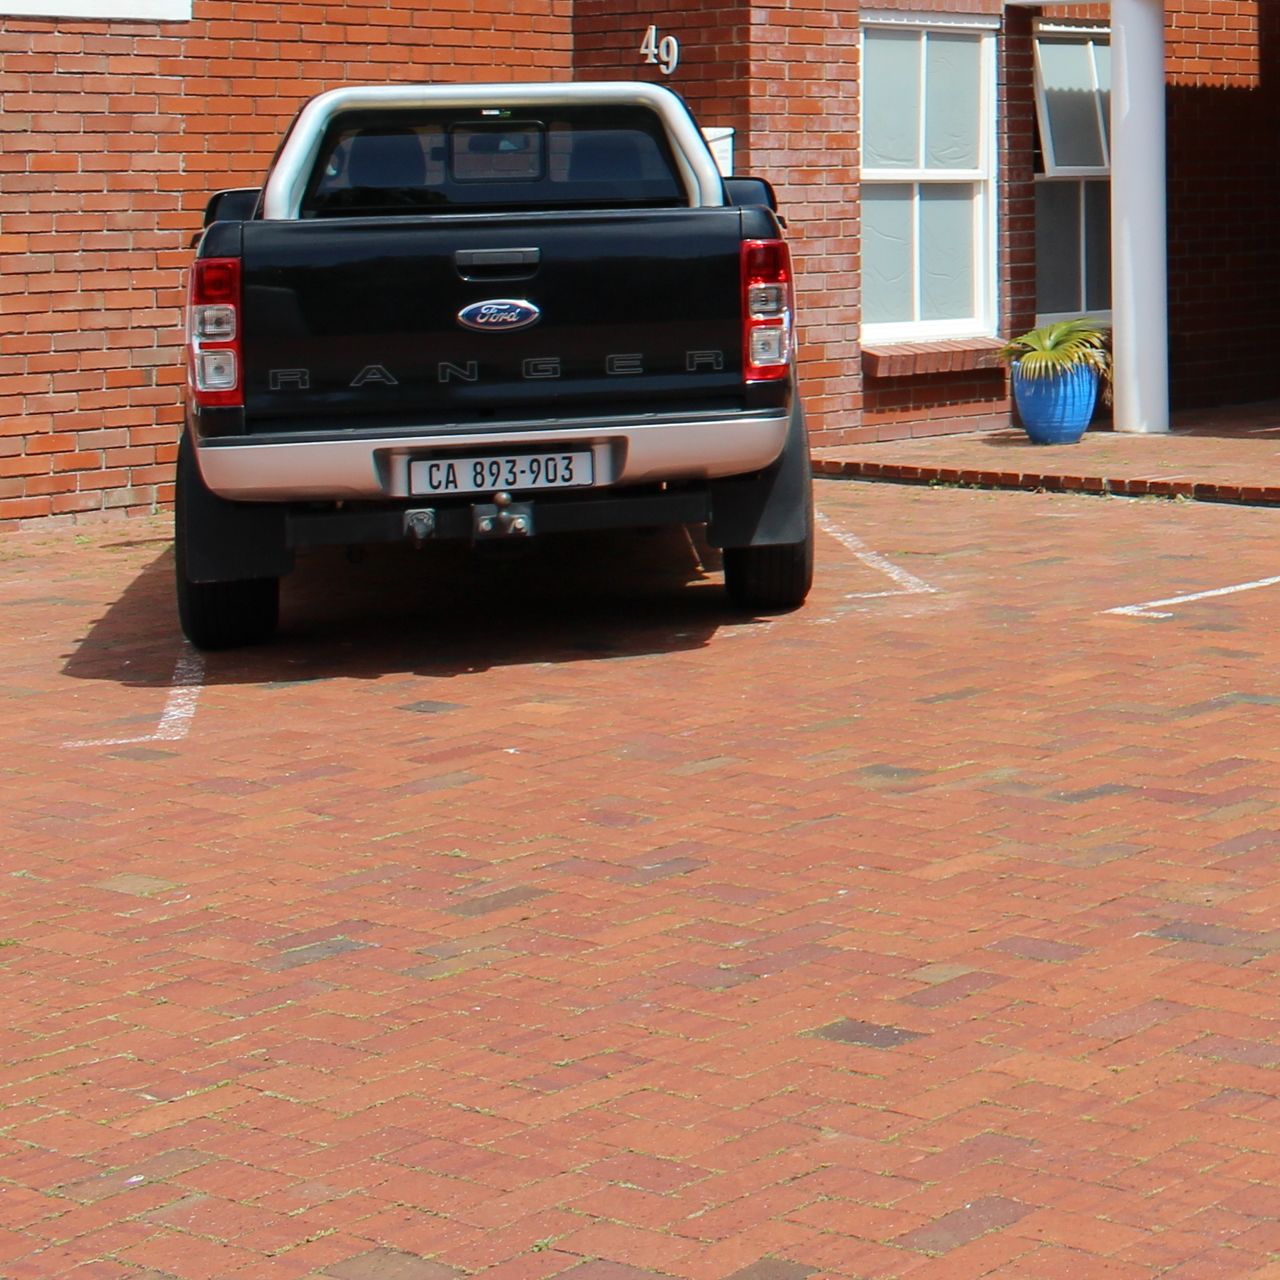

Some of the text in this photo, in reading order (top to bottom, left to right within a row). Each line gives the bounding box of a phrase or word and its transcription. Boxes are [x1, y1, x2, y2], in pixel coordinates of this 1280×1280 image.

[640, 24, 678, 74] 49
[477, 304, 520, 323] Ford
[269, 350, 724, 390] RANGER
[429, 456, 573, 490] CA 893-903
